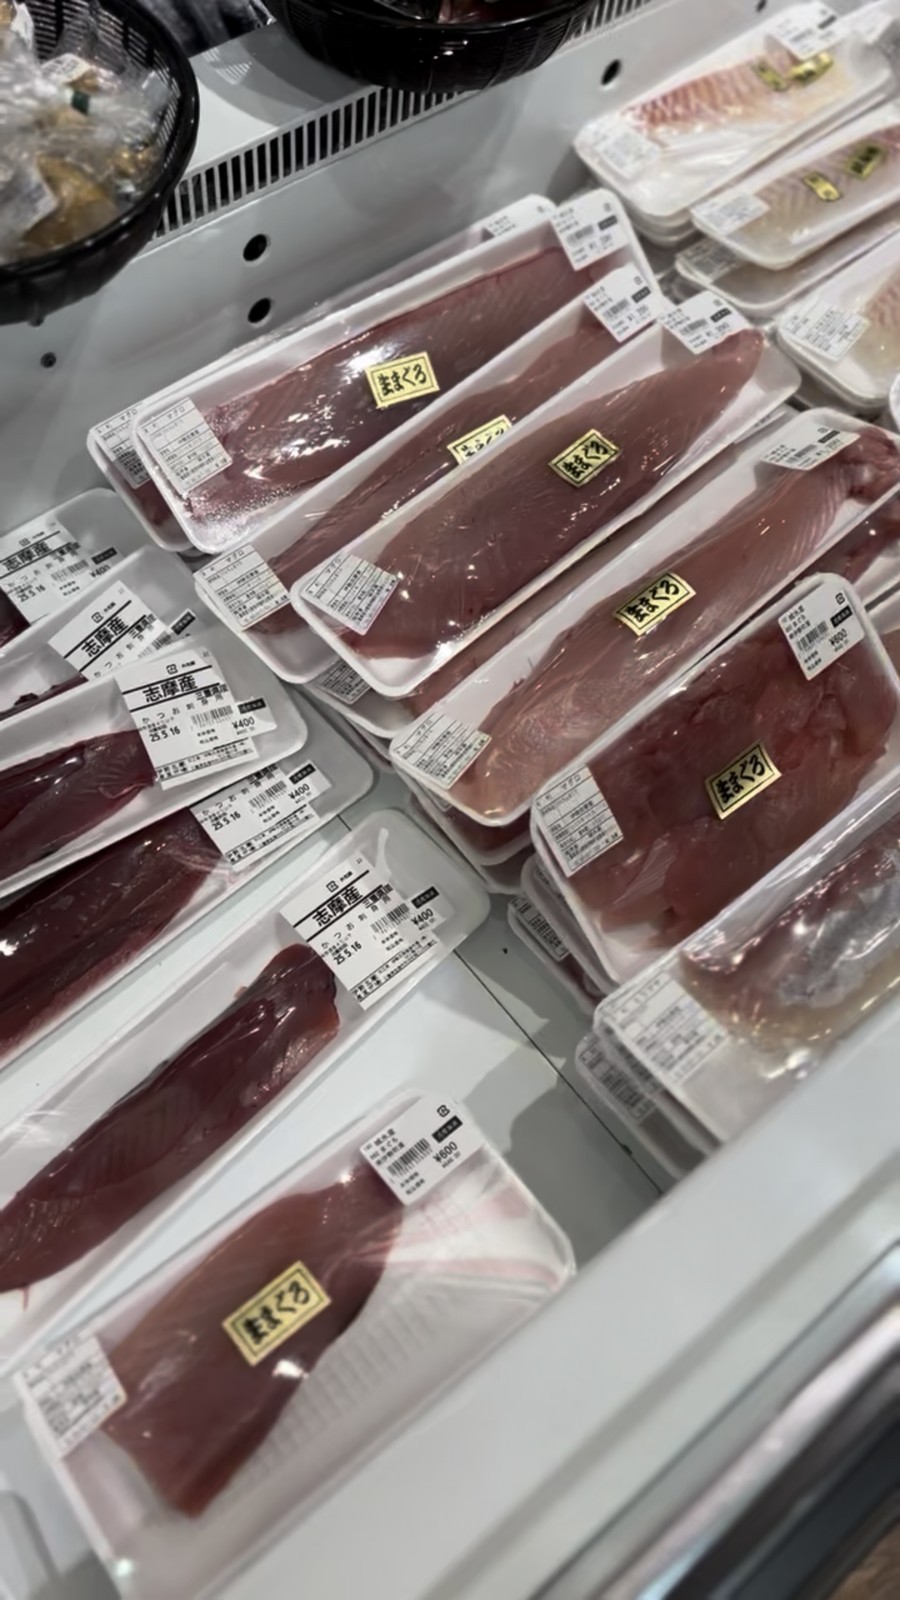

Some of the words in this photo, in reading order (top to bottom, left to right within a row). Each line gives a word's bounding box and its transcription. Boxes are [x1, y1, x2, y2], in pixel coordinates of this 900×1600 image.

[81, 616, 129, 657] 志摩産
[142, 674, 198, 703] 志摩産
[232, 716, 256, 730] ¥400
[288, 783, 310, 799] ¥400
[312, 885, 363, 927] 志摩産
[411, 908, 434, 926] ¥400
[432, 1141, 458, 1163] ¥600
